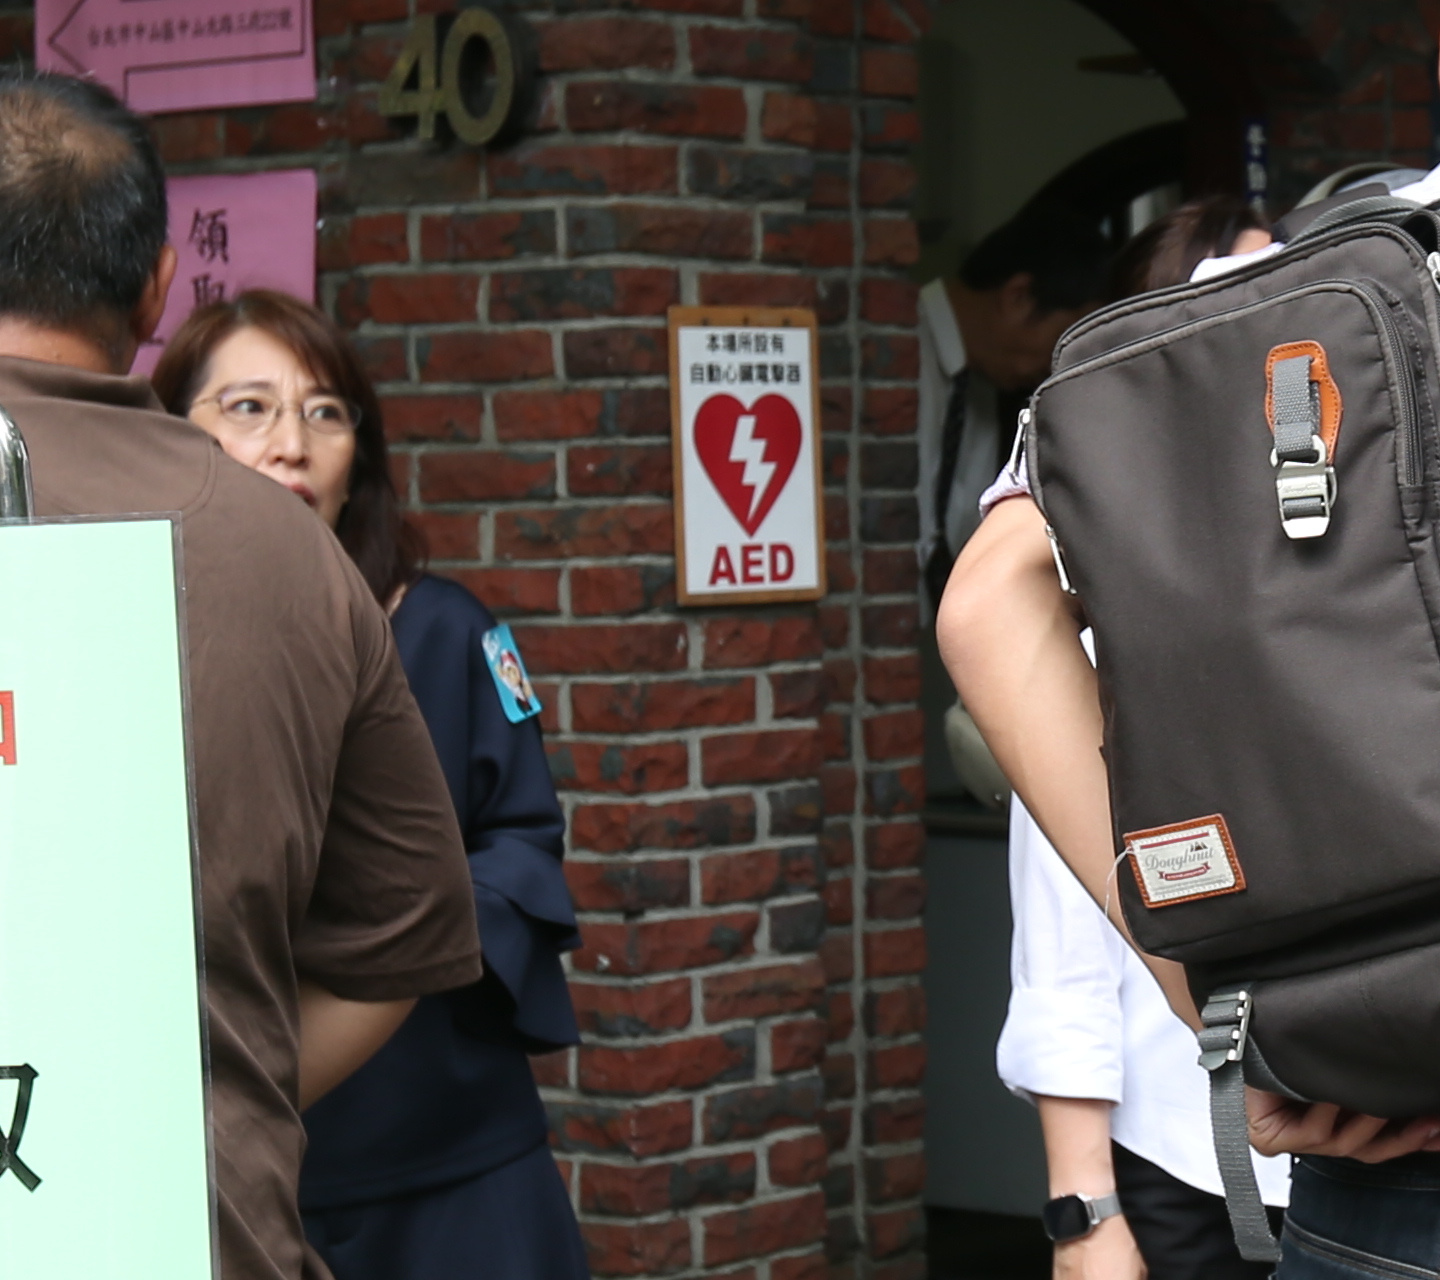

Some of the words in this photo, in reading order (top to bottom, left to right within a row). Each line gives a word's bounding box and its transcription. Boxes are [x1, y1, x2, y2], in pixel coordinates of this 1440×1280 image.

[379, 6, 518, 146] 40
[705, 333, 786, 355] 本場所設有
[708, 542, 795, 587] AED
[1144, 846, 1215, 872] Doughnut
